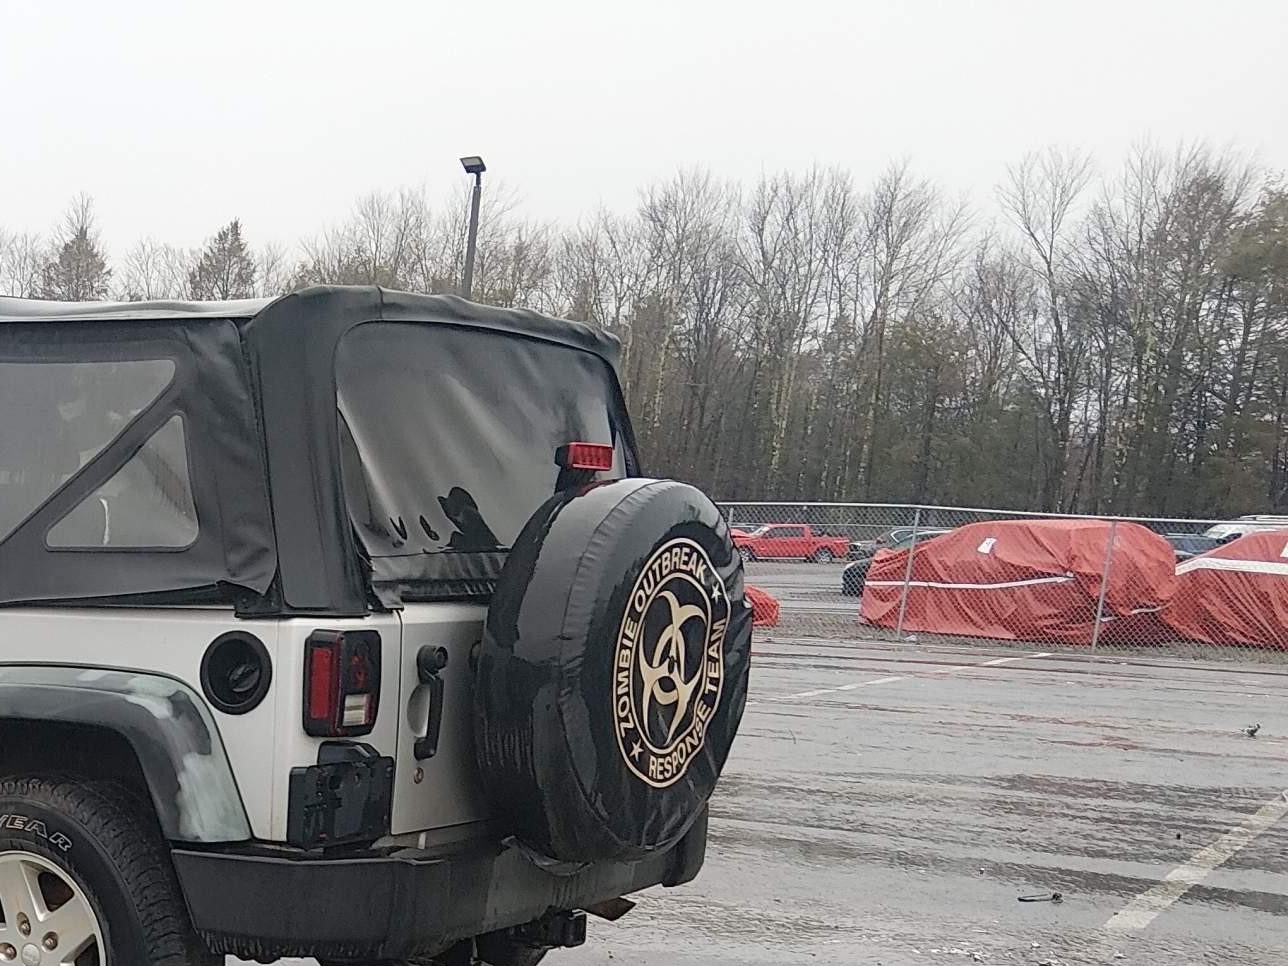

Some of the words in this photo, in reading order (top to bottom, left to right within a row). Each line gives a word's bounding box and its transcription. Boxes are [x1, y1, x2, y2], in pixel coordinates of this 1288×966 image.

[616, 619, 639, 737] ZOMBIE
[634, 547, 707, 613] OUTBREAK
[648, 700, 711, 779] RESPONSE
[705, 618, 725, 694] TEAM
